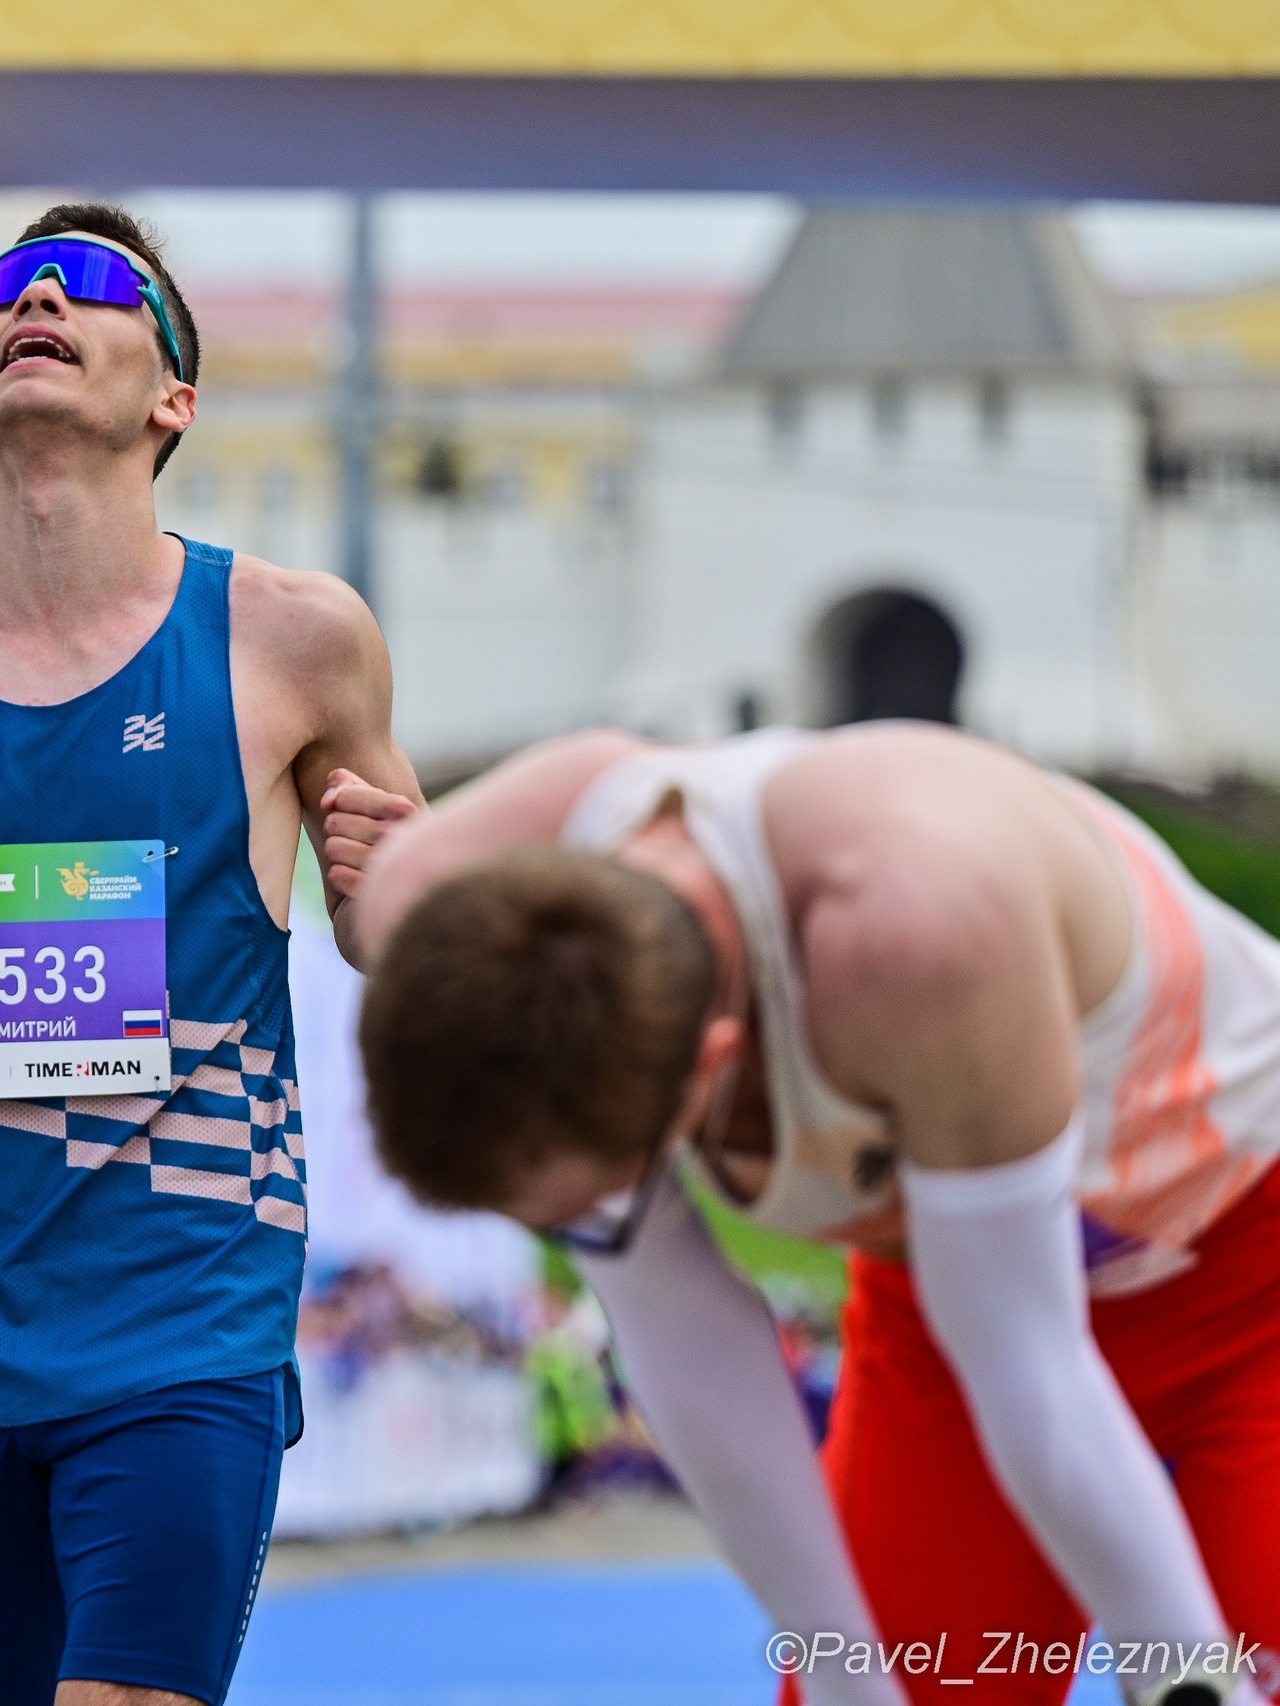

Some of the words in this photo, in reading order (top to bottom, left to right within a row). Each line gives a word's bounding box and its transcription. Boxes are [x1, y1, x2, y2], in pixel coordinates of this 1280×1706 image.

[89, 875, 138, 885] СБЕРПРАЙМ
[89, 882, 143, 893] КАЗАНСКИЙ
[89, 892, 132, 900] МАРАФОН
